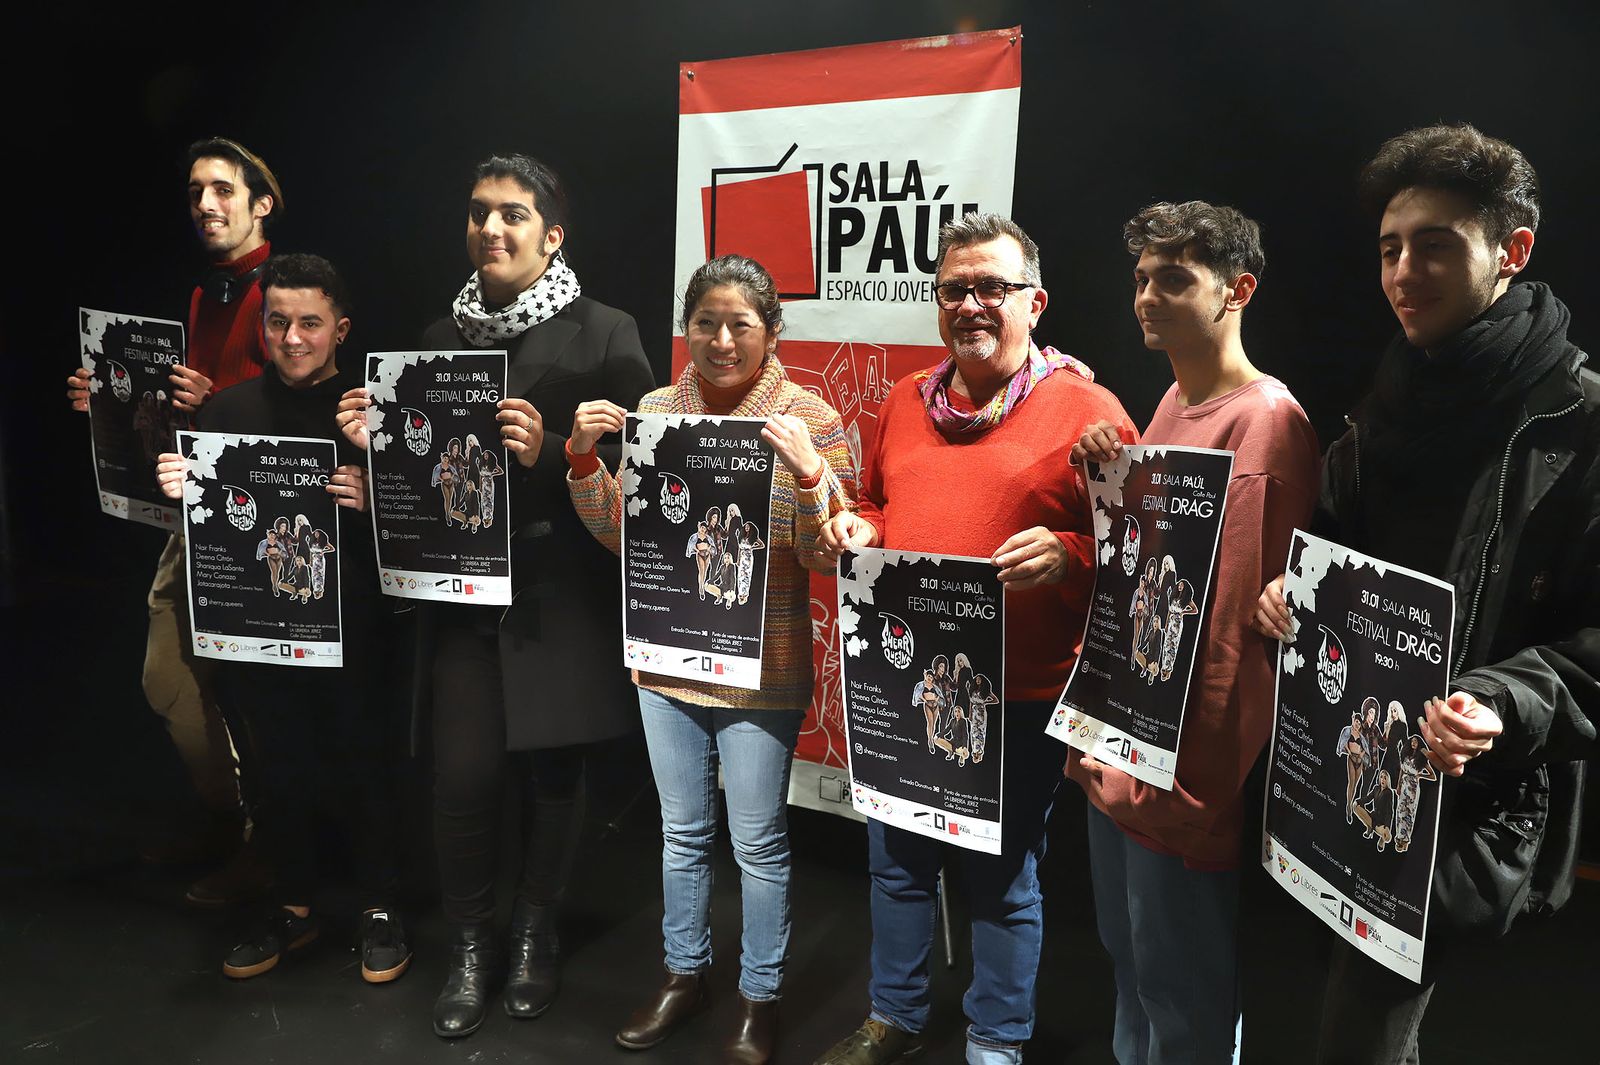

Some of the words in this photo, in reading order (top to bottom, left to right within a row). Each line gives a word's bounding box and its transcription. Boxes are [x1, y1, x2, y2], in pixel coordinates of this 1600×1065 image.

[829, 160, 925, 203] SALA
[827, 185, 979, 275] PAÚ
[827, 281, 888, 301] ESPACIO
[124, 348, 152, 362] FESTIVAL
[154, 353, 179, 365] DRAG
[436, 373, 450, 381] 31.01
[454, 373, 470, 381] SALA
[472, 371, 489, 381] PAÚL
[426, 390, 463, 402] FESTIVAL
[466, 390, 498, 402] DRAG
[699, 438, 716, 448] 31.01
[720, 439, 738, 448] SALA
[740, 439, 759, 450] PAÚL
[260, 456, 277, 465] 31.01
[280, 457, 299, 466] SALA
[301, 458, 319, 467] PAÚL
[687, 455, 727, 470] FESTIVAL
[731, 457, 768, 472] DRAG
[250, 471, 290, 485] FESTIVAL
[294, 474, 330, 486] DRAG
[1163, 474, 1180, 486] SALA
[1182, 475, 1204, 489] PAÚL
[1142, 495, 1167, 512] FESTIVAL
[1171, 497, 1214, 518] DRAG
[1169, 522, 1172, 530] h
[642, 540, 658, 548] Franks
[630, 549, 647, 558] Deena
[648, 551, 663, 559] Citrón
[196, 562, 221, 570] Shaniqua
[222, 564, 244, 572] LaSanta
[630, 559, 651, 569] Shaniqua
[653, 561, 674, 571] LaSanta
[196, 571, 212, 580] Mary
[630, 570, 643, 579] Mary
[644, 571, 665, 580] Conazo
[920, 578, 938, 590] 31.01
[941, 581, 961, 592] SALA
[964, 582, 984, 594] PAÚL
[908, 596, 951, 615] FESTIVAL
[955, 602, 996, 620] DRAG
[1361, 590, 1379, 608] 31.01
[1382, 599, 1406, 618] SALA
[1409, 607, 1432, 627] PAÚL
[1347, 611, 1390, 646] FESTIVAL
[1396, 630, 1442, 664] DRAG
[1394, 661, 1399, 671] h
[864, 683, 881, 693] Franks
[851, 691, 870, 702] Deena
[871, 695, 888, 705] Citrón
[852, 701, 875, 714] Shaniqua
[877, 707, 899, 718] LaSanta
[852, 713, 867, 723] Mary
[868, 716, 891, 727] Conazo
[1280, 716, 1296, 735] Deena
[1292, 709, 1309, 727] Franks
[1278, 744, 1291, 761] Mary
[1301, 745, 1322, 766] LaSanta
